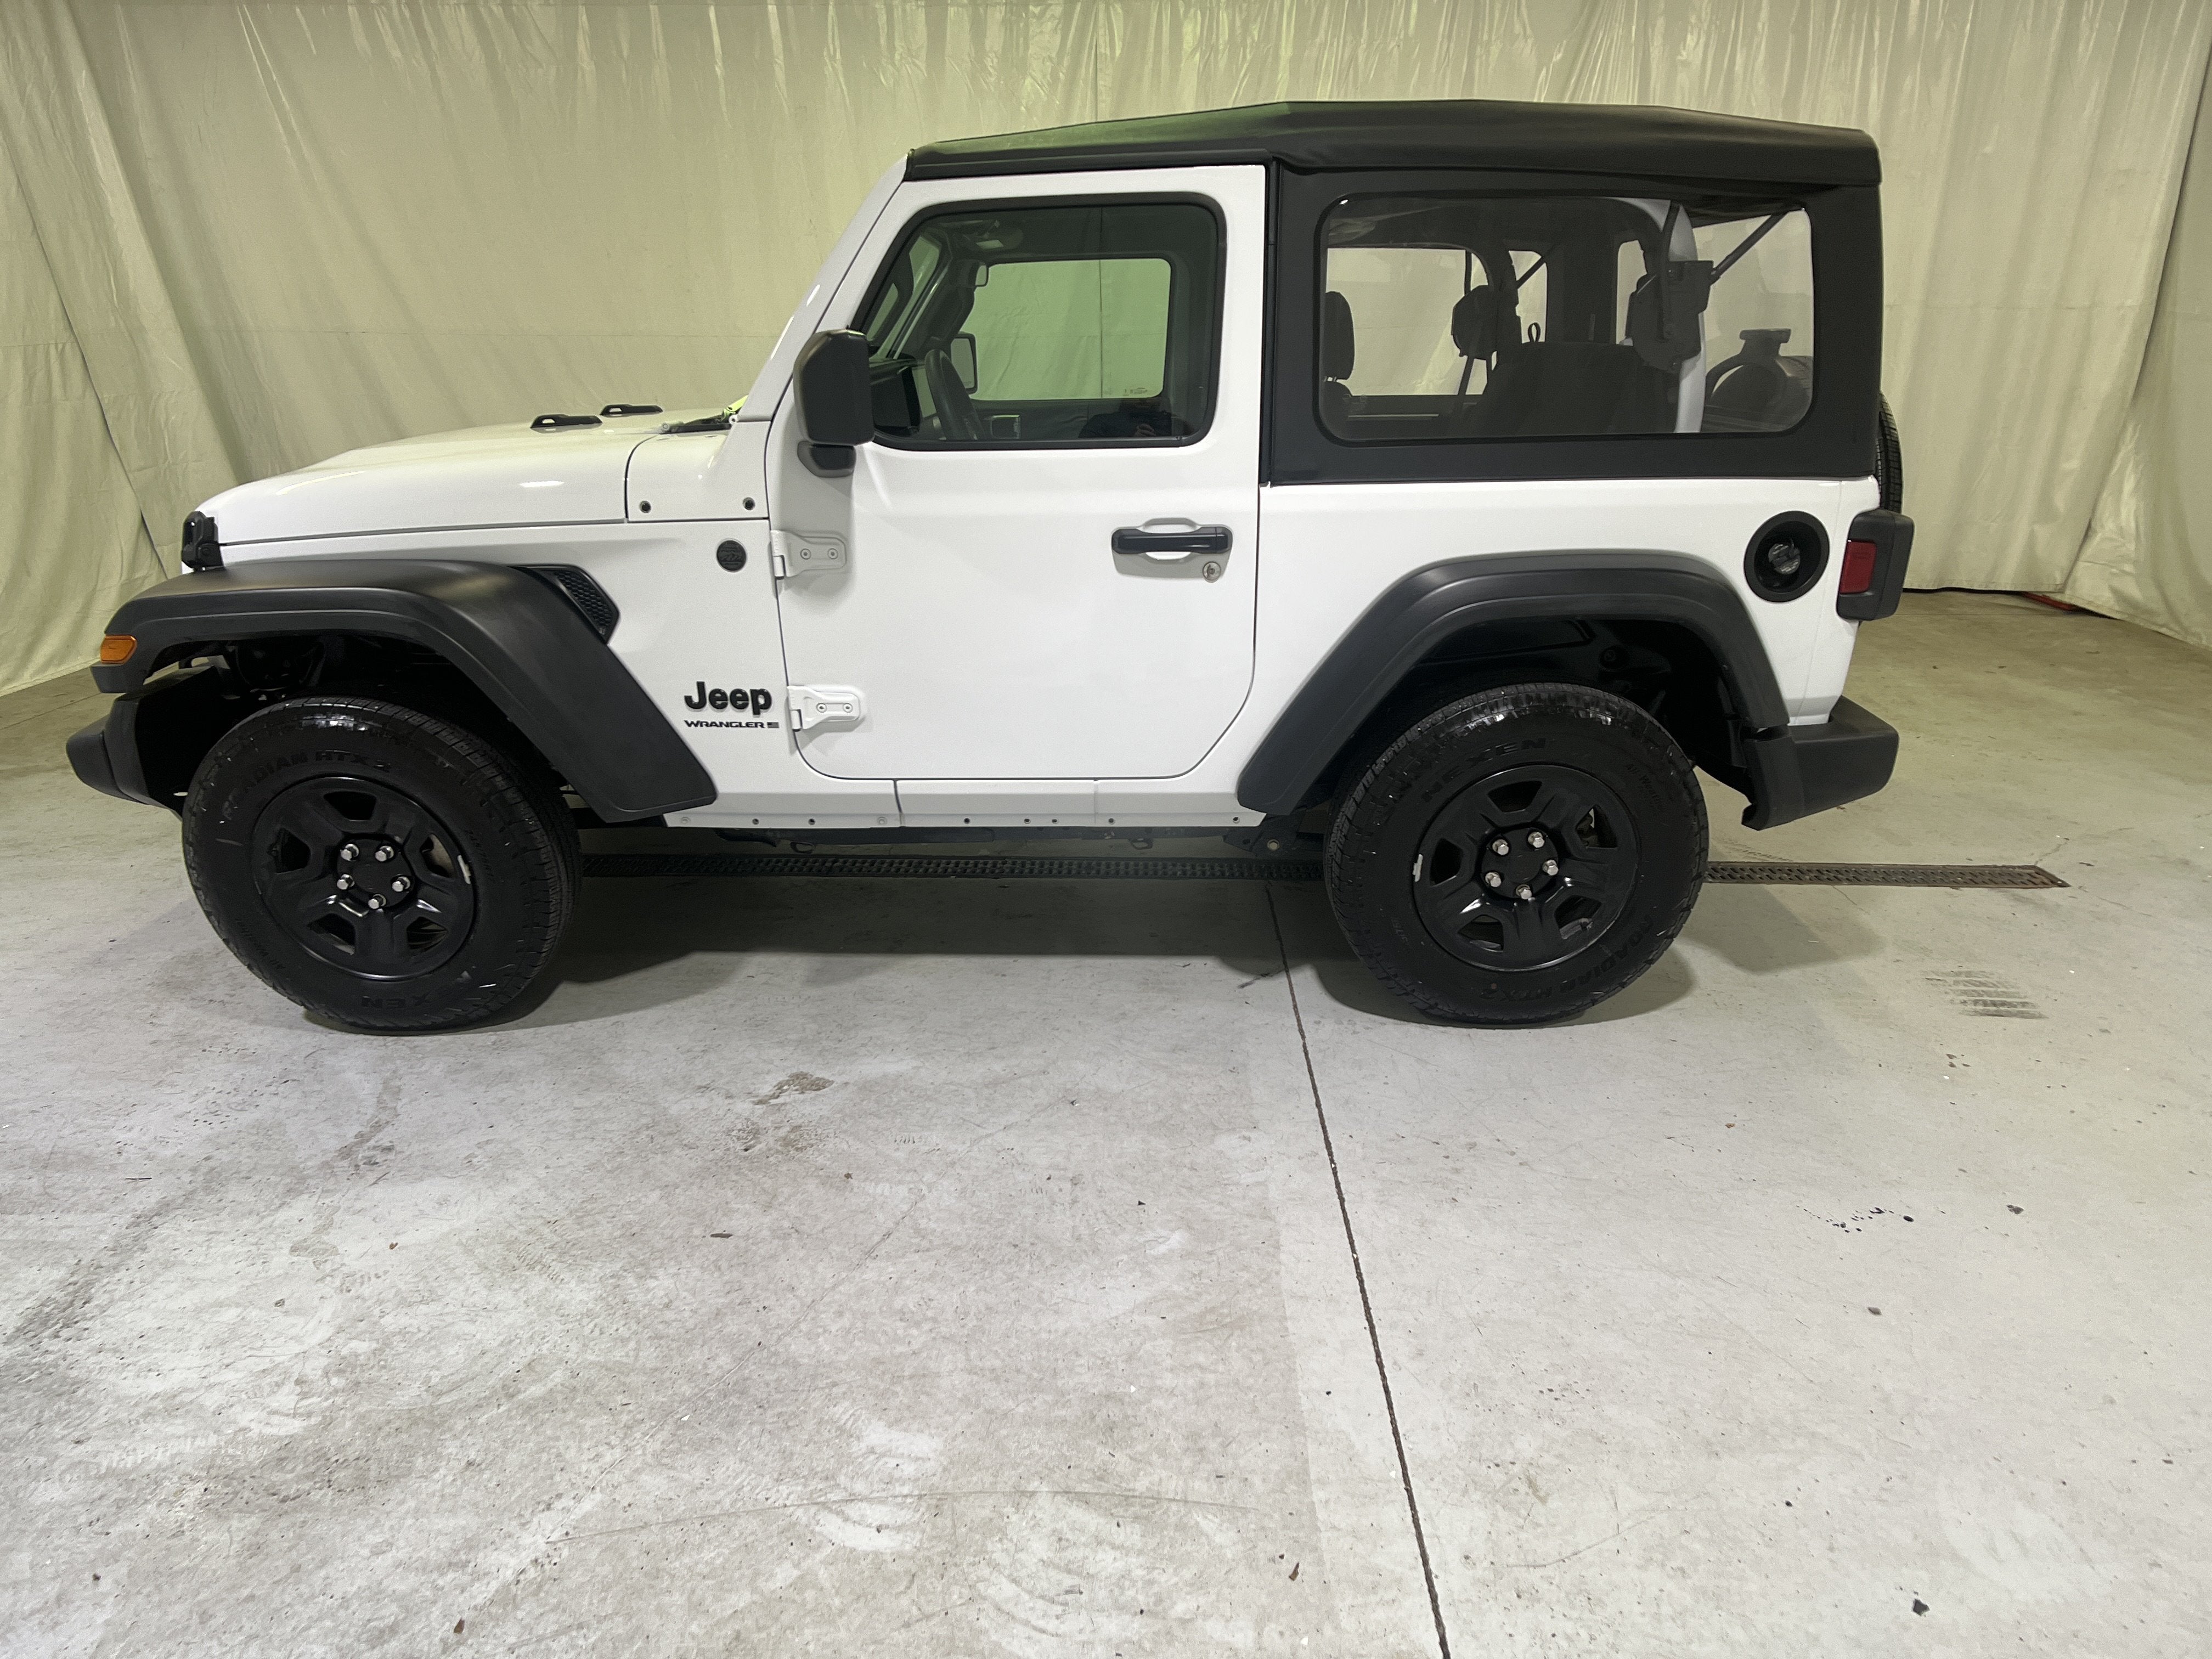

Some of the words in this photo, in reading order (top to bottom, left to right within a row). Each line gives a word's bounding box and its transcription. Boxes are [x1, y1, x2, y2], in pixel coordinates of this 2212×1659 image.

[684, 681, 772, 715] Jeep
[684, 720, 765, 729] WRANGLER
[1420, 737, 1547, 803] NEXEN
